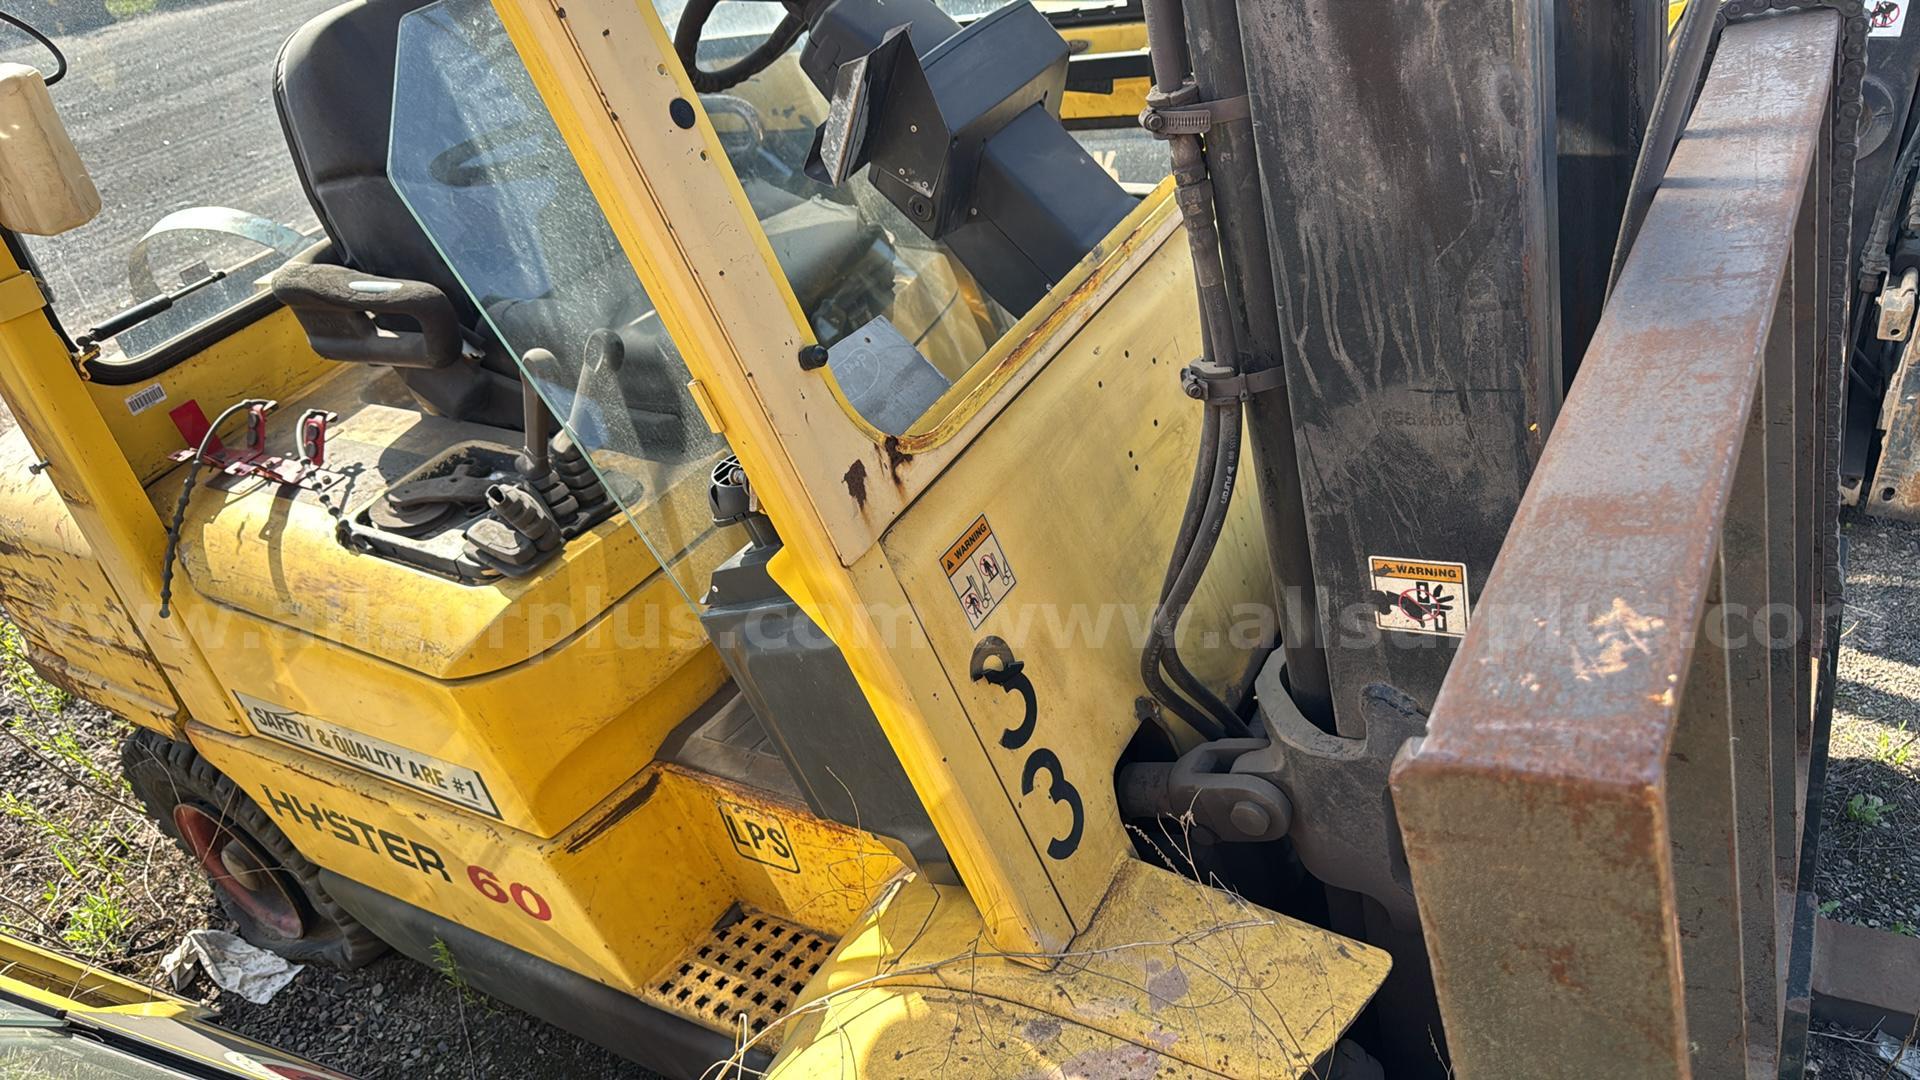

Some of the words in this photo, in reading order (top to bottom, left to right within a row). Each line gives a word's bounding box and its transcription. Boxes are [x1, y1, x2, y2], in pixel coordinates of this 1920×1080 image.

[953, 523, 987, 560] WARNING
[1396, 564, 1457, 578] WARNING
[253, 706, 315, 743] SAFETY
[316, 728, 332, 750] &
[332, 733, 404, 774] QUALITY
[409, 760, 449, 789] ARE
[452, 777, 479, 800] #1
[260, 784, 453, 883] HYSTER
[466, 865, 552, 921] 60
[726, 815, 790, 858] LPS
